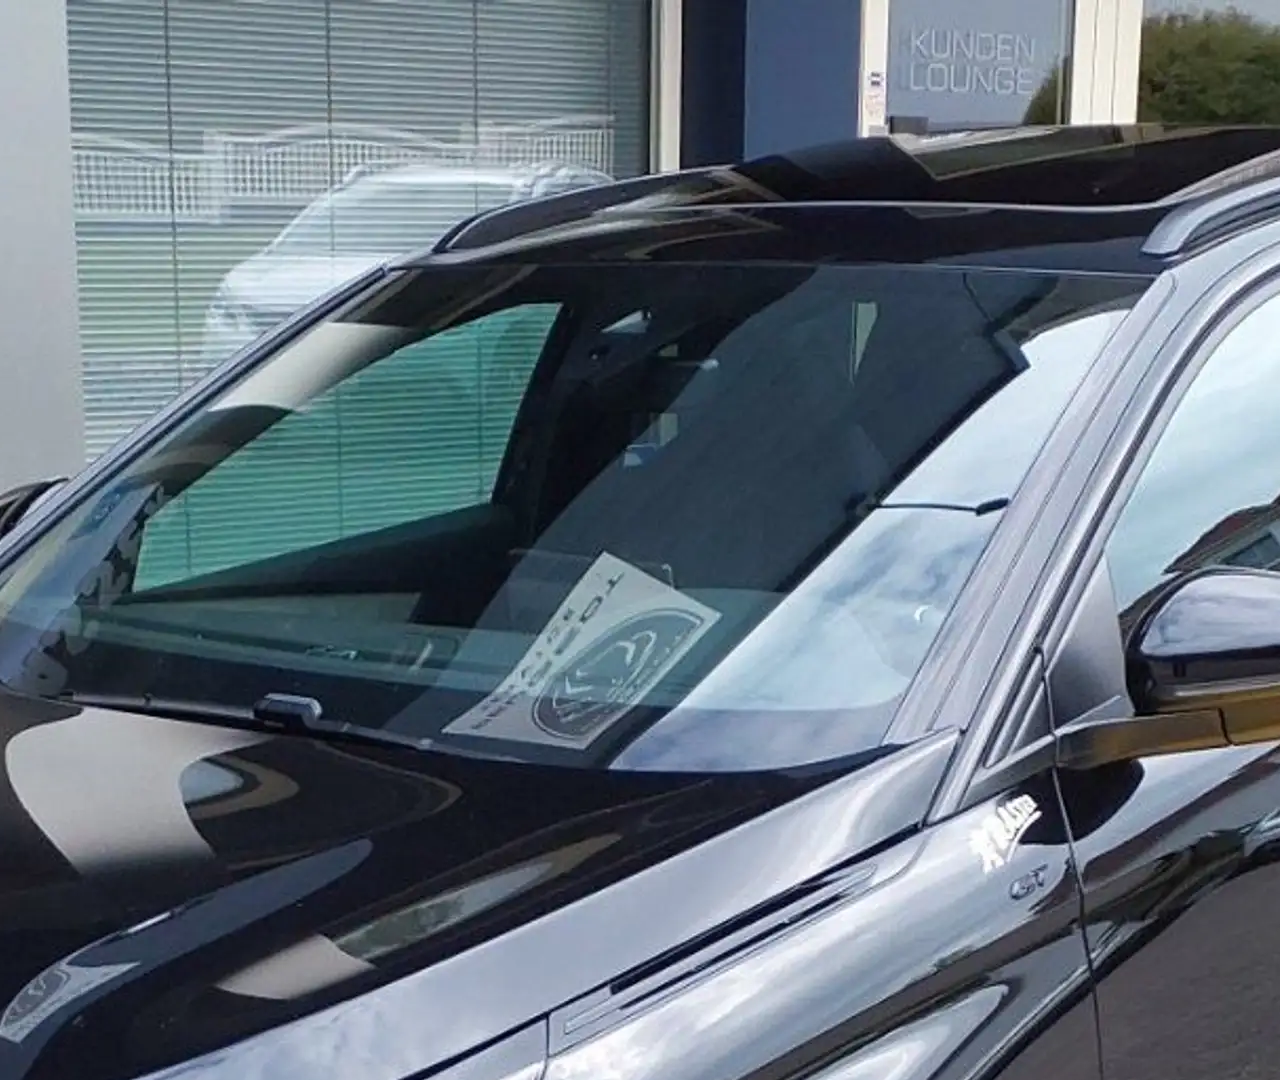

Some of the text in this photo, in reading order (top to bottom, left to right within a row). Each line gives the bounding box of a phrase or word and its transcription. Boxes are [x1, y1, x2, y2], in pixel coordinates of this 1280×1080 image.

[909, 29, 1036, 62] KUNDEN
[909, 63, 1035, 95] LOUNGE
[1008, 863, 1049, 901] GT
